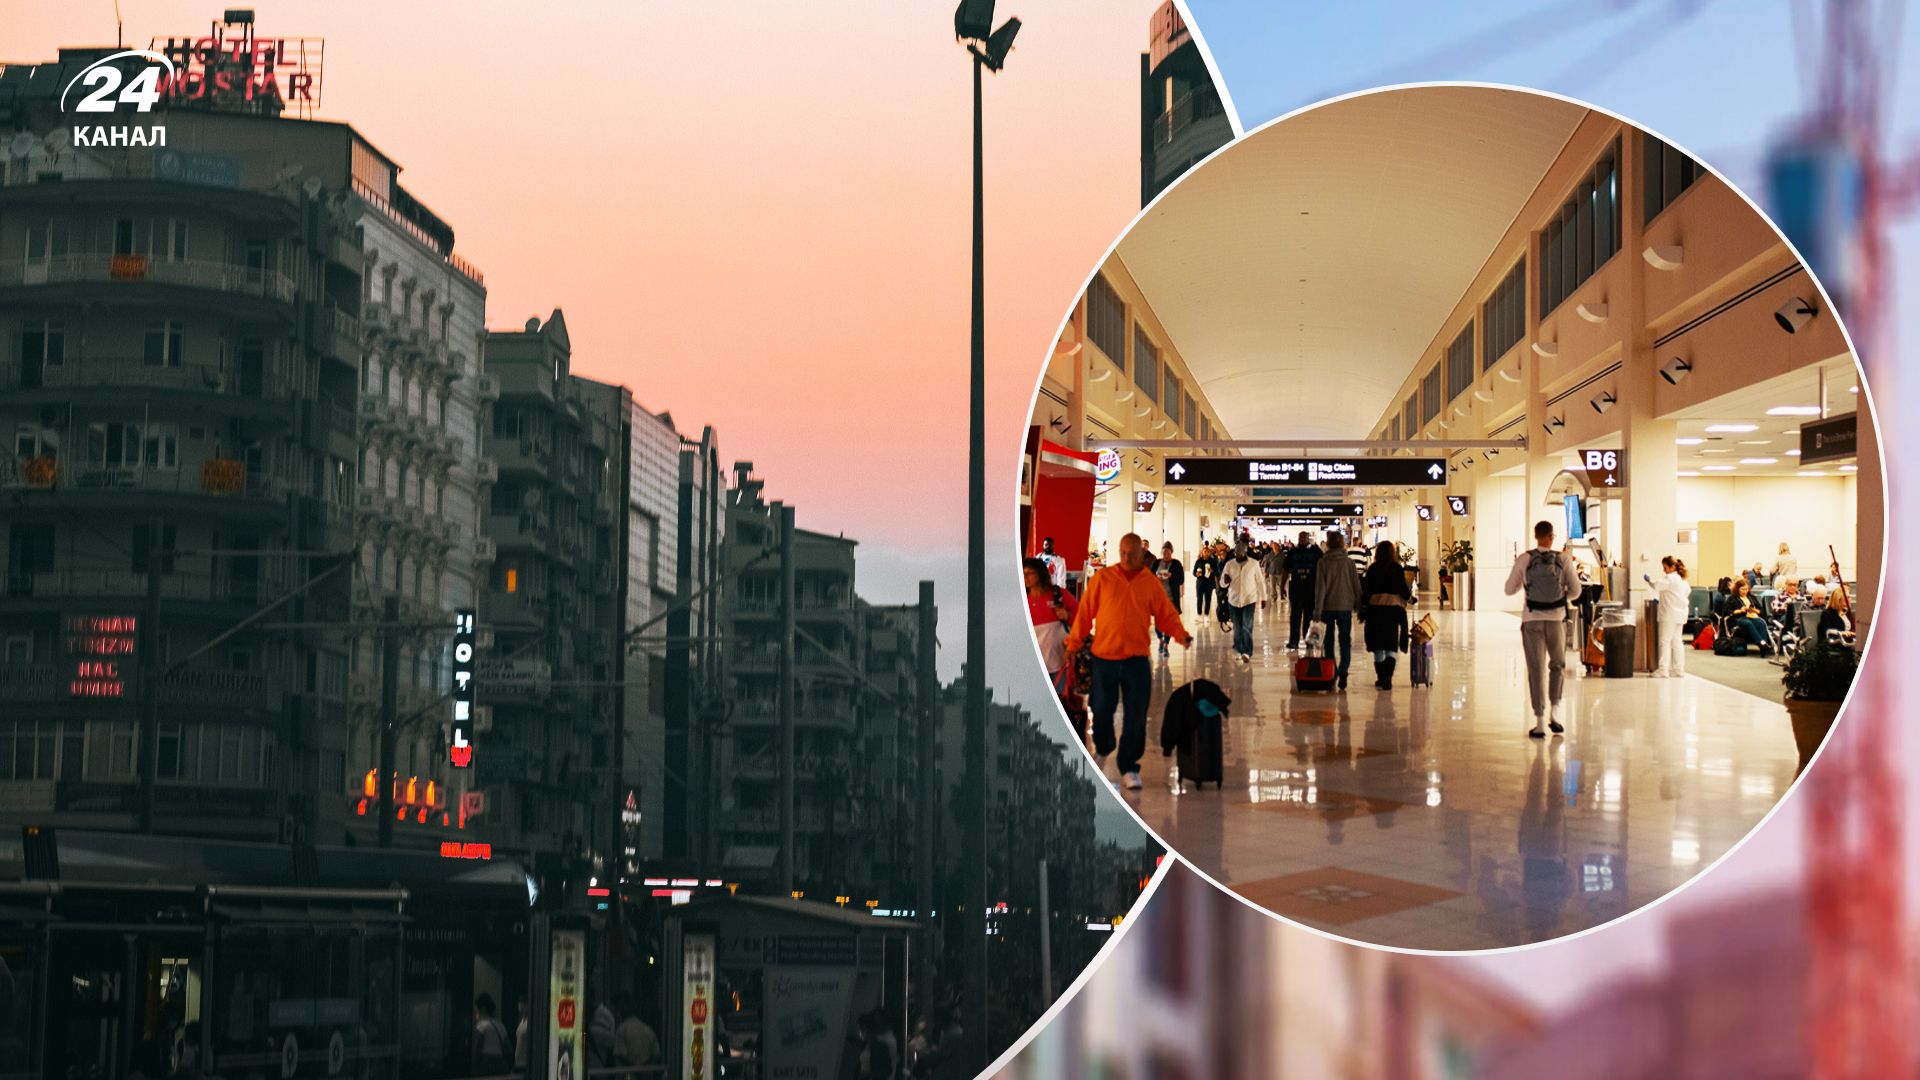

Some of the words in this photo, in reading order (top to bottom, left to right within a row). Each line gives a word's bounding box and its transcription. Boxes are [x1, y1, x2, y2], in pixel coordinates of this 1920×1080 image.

[166, 37, 297, 66] HOTEL
[155, 72, 313, 101] MOSTAR
[1099, 459, 1117, 471] ING
[1259, 463, 1281, 471] Gates
[1586, 451, 1617, 471] B6
[1318, 463, 1333, 473] Bag
[1333, 463, 1355, 471] Claim
[1259, 472, 1290, 480] Terminal
[1318, 472, 1356, 480] Restrooms
[1137, 492, 1155, 504] B3
[454, 614, 473, 749] HOTEL
